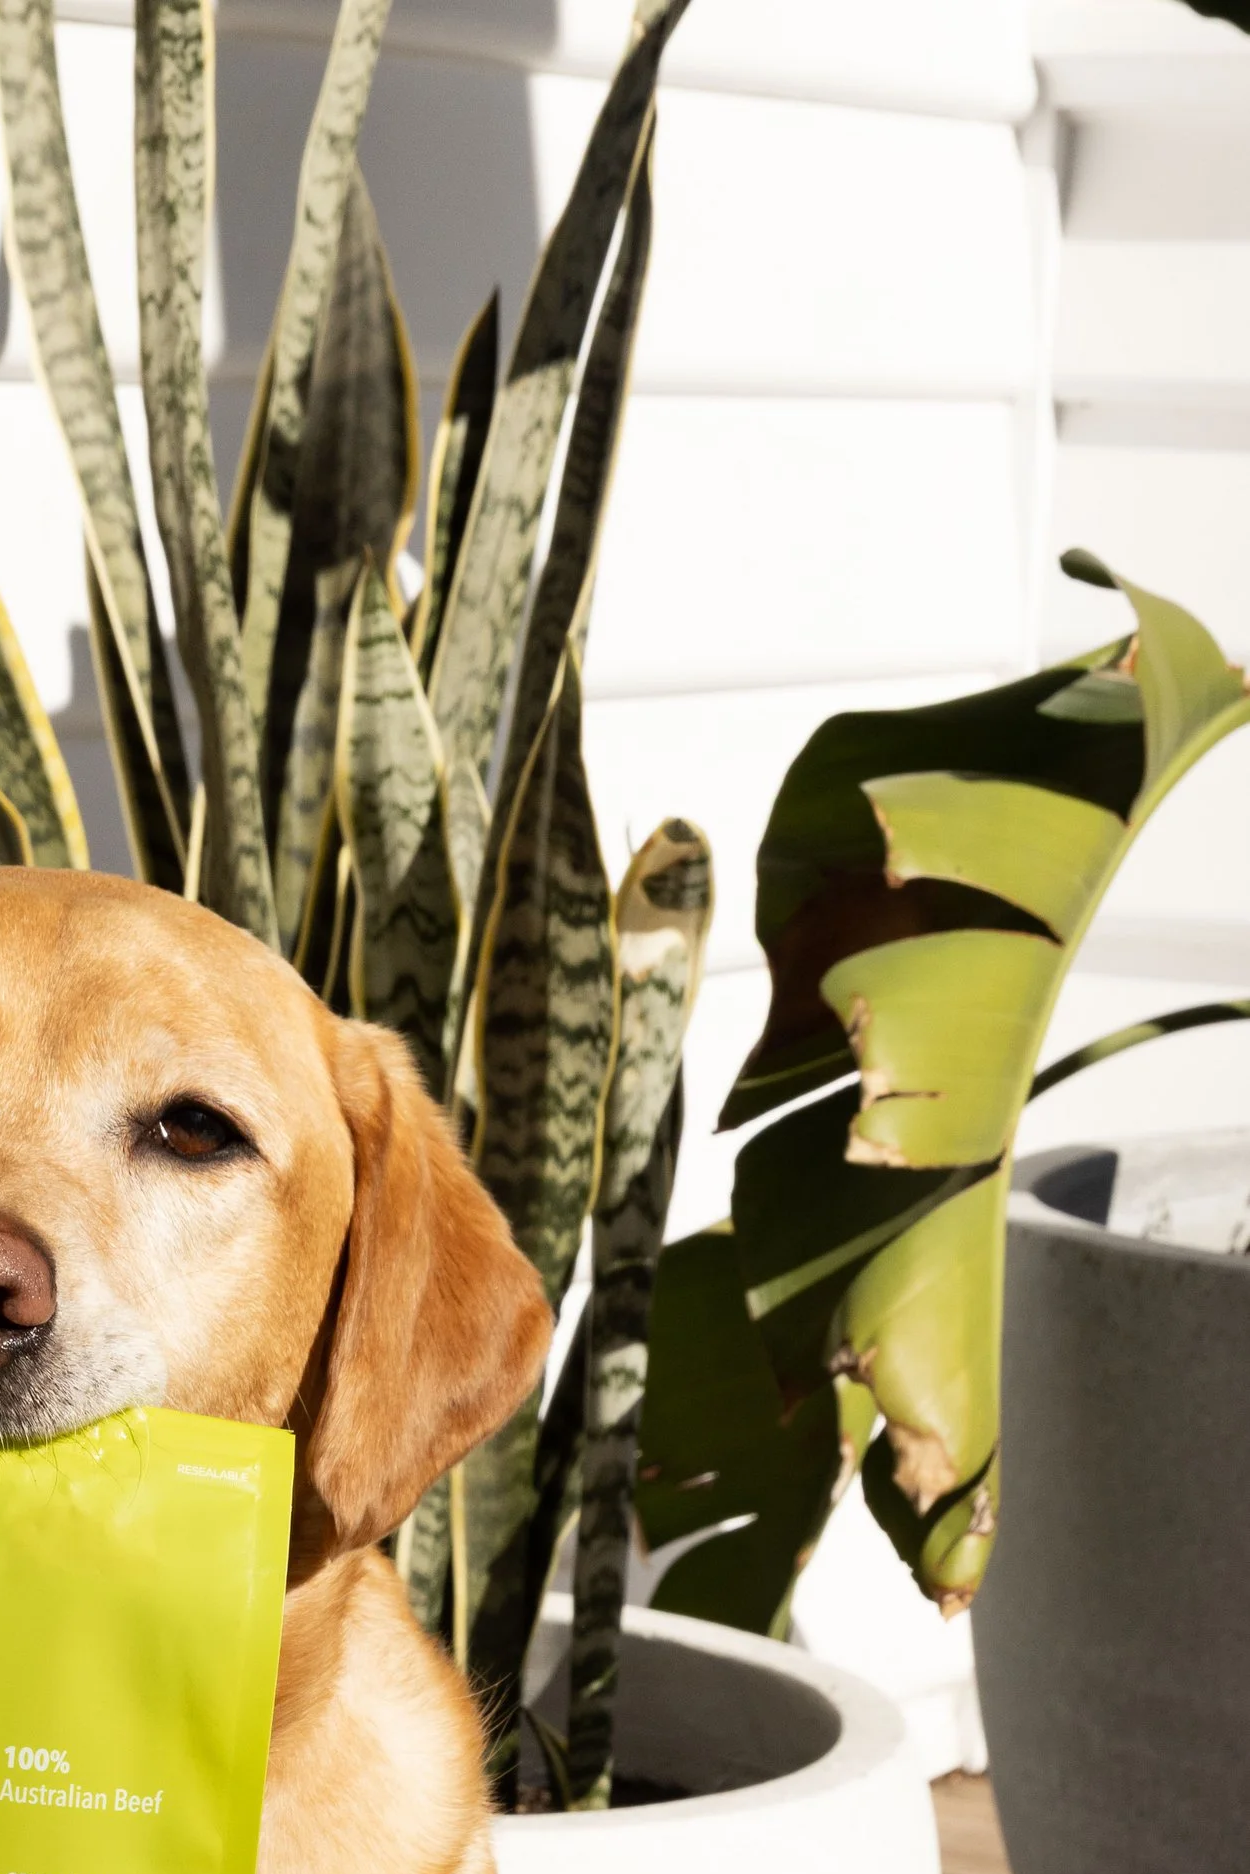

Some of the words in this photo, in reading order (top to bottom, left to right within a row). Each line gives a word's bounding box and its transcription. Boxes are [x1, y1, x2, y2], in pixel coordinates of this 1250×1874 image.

[177, 1463, 249, 1482] RESEALABLE
[4, 1745, 71, 1774] 100%
[113, 1788, 164, 1816] Beef
